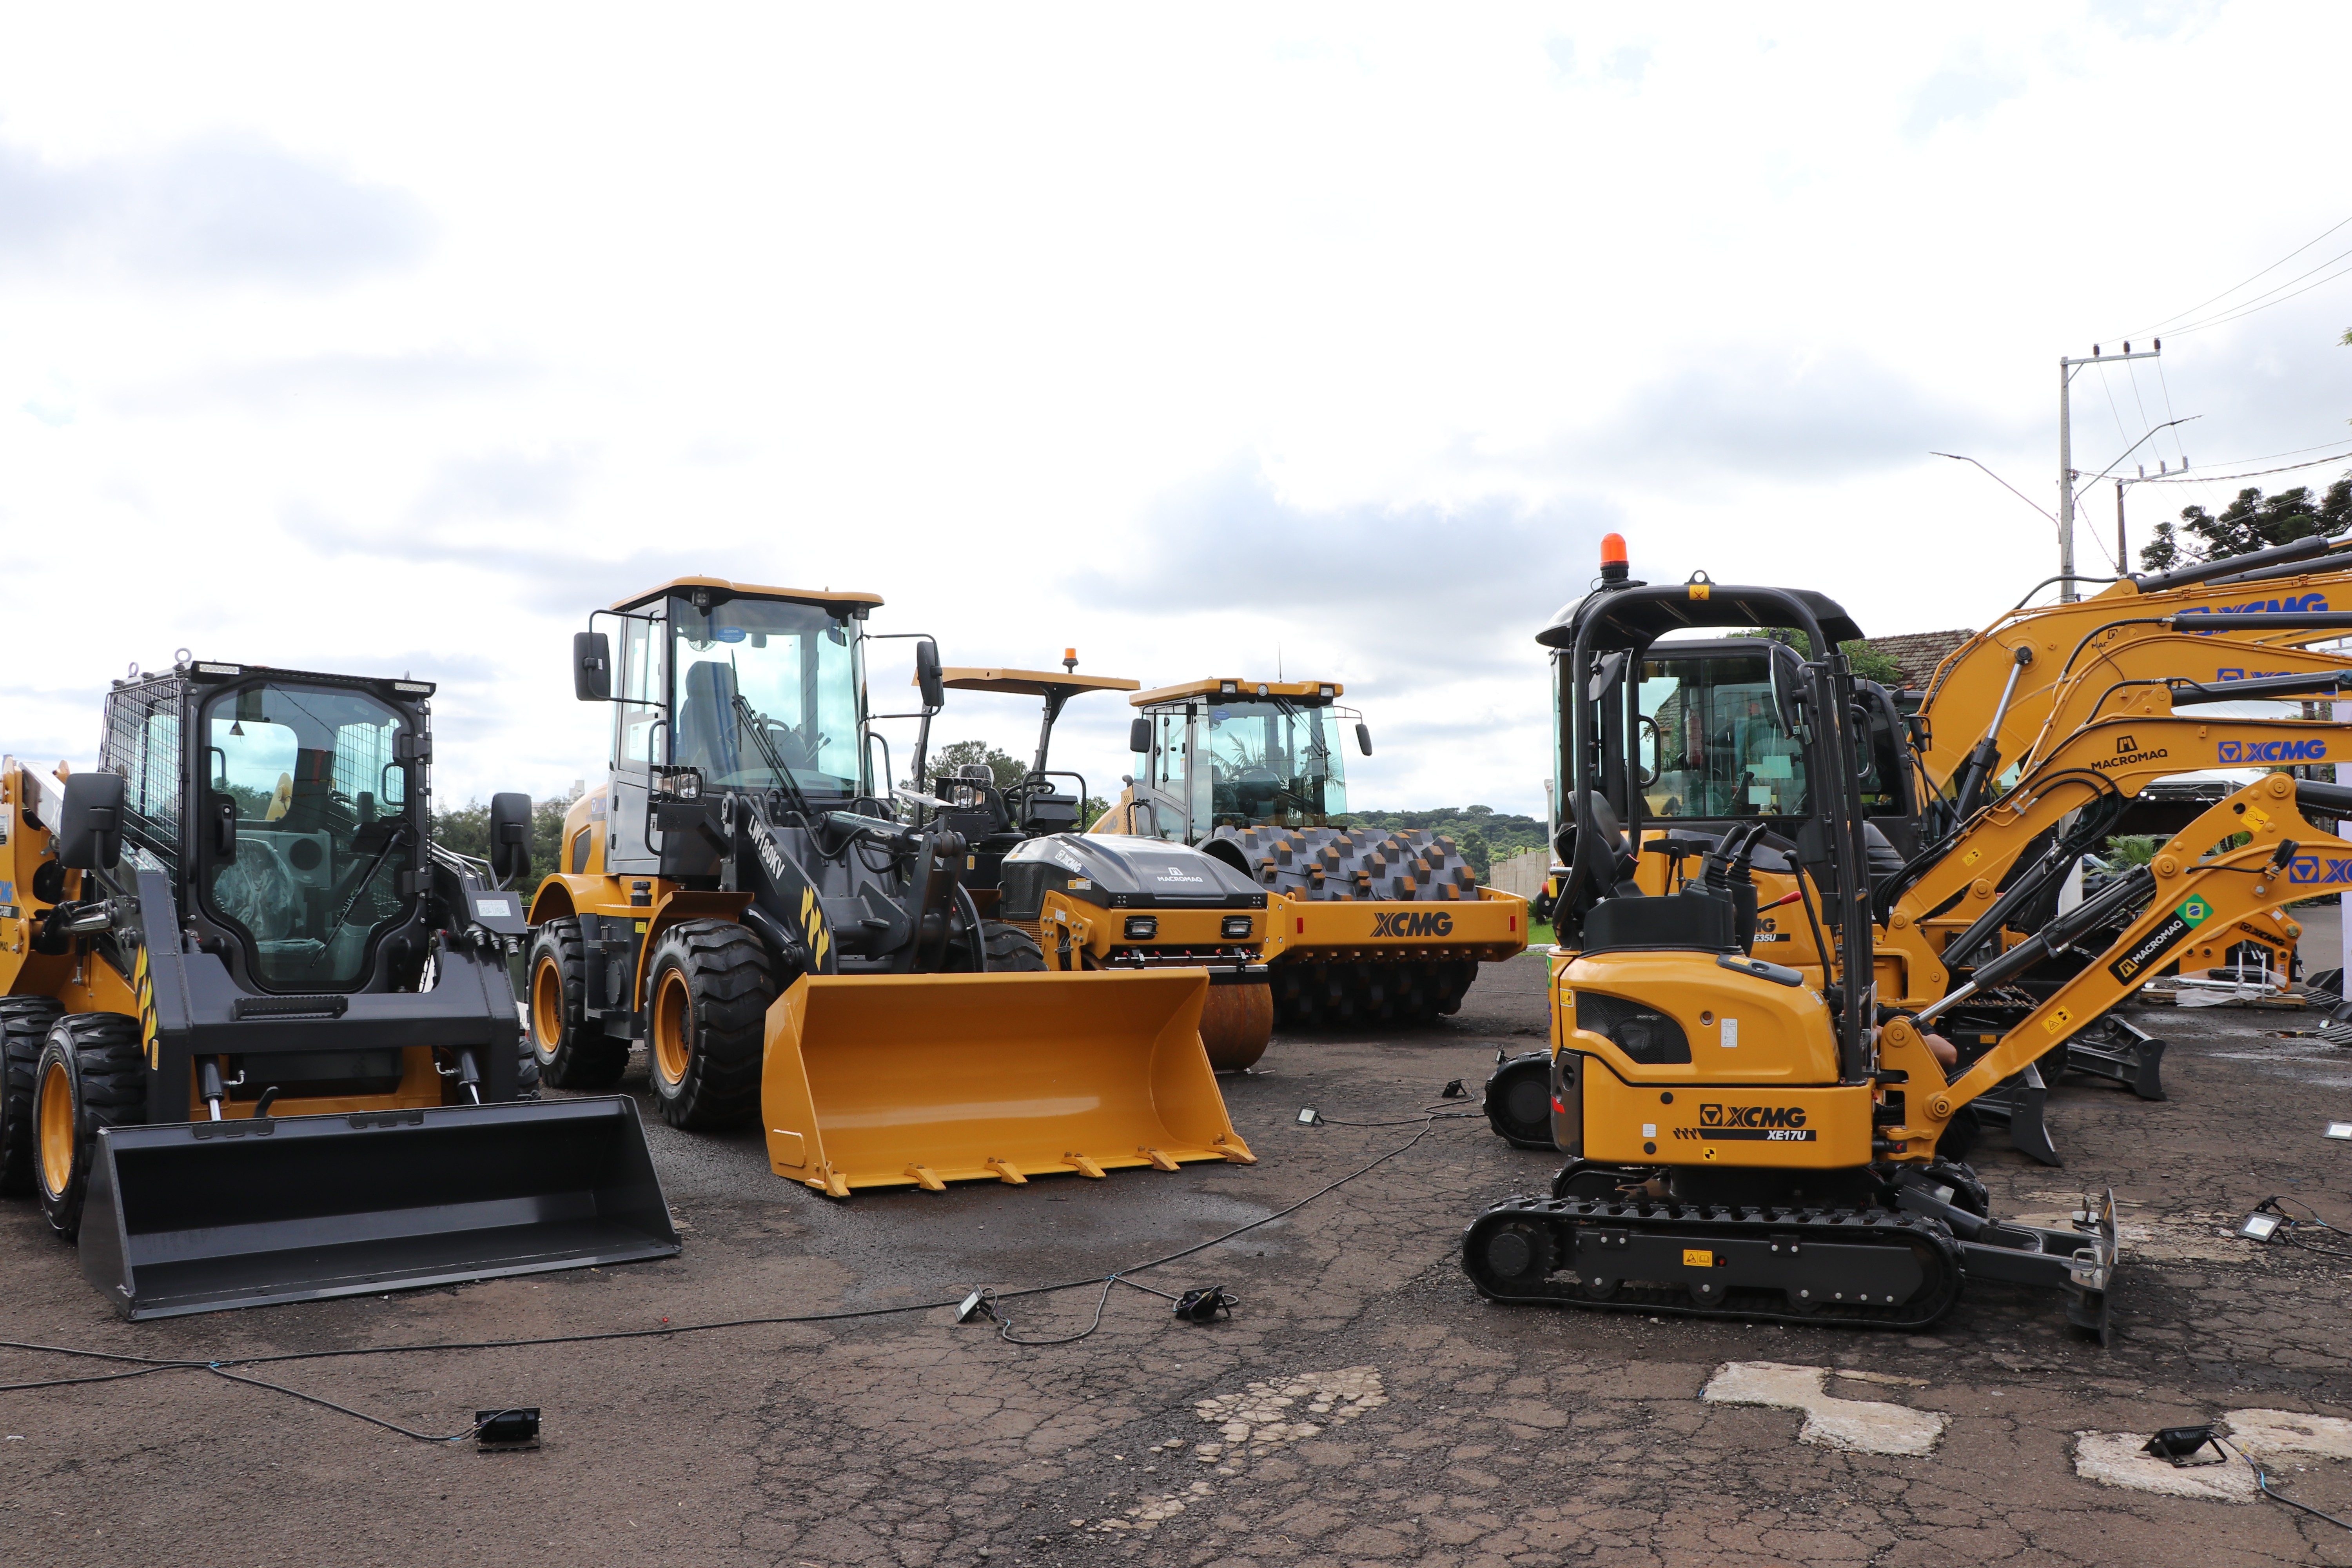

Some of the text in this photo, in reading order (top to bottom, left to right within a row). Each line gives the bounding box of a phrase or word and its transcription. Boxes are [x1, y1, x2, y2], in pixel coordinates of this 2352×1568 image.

[2091, 749, 2168, 770] MACROMAQ
[2242, 739, 2327, 762] XCMG
[747, 814, 785, 880] LW180KV
[1060, 854, 1082, 873] XCMG
[1369, 911, 1453, 937] XCMG
[2132, 920, 2184, 964] MACROMAQ
[2249, 927, 2285, 946] XCMG
[1723, 1107, 1807, 1128] XCMG
[1766, 1130, 1807, 1141] XE17U
